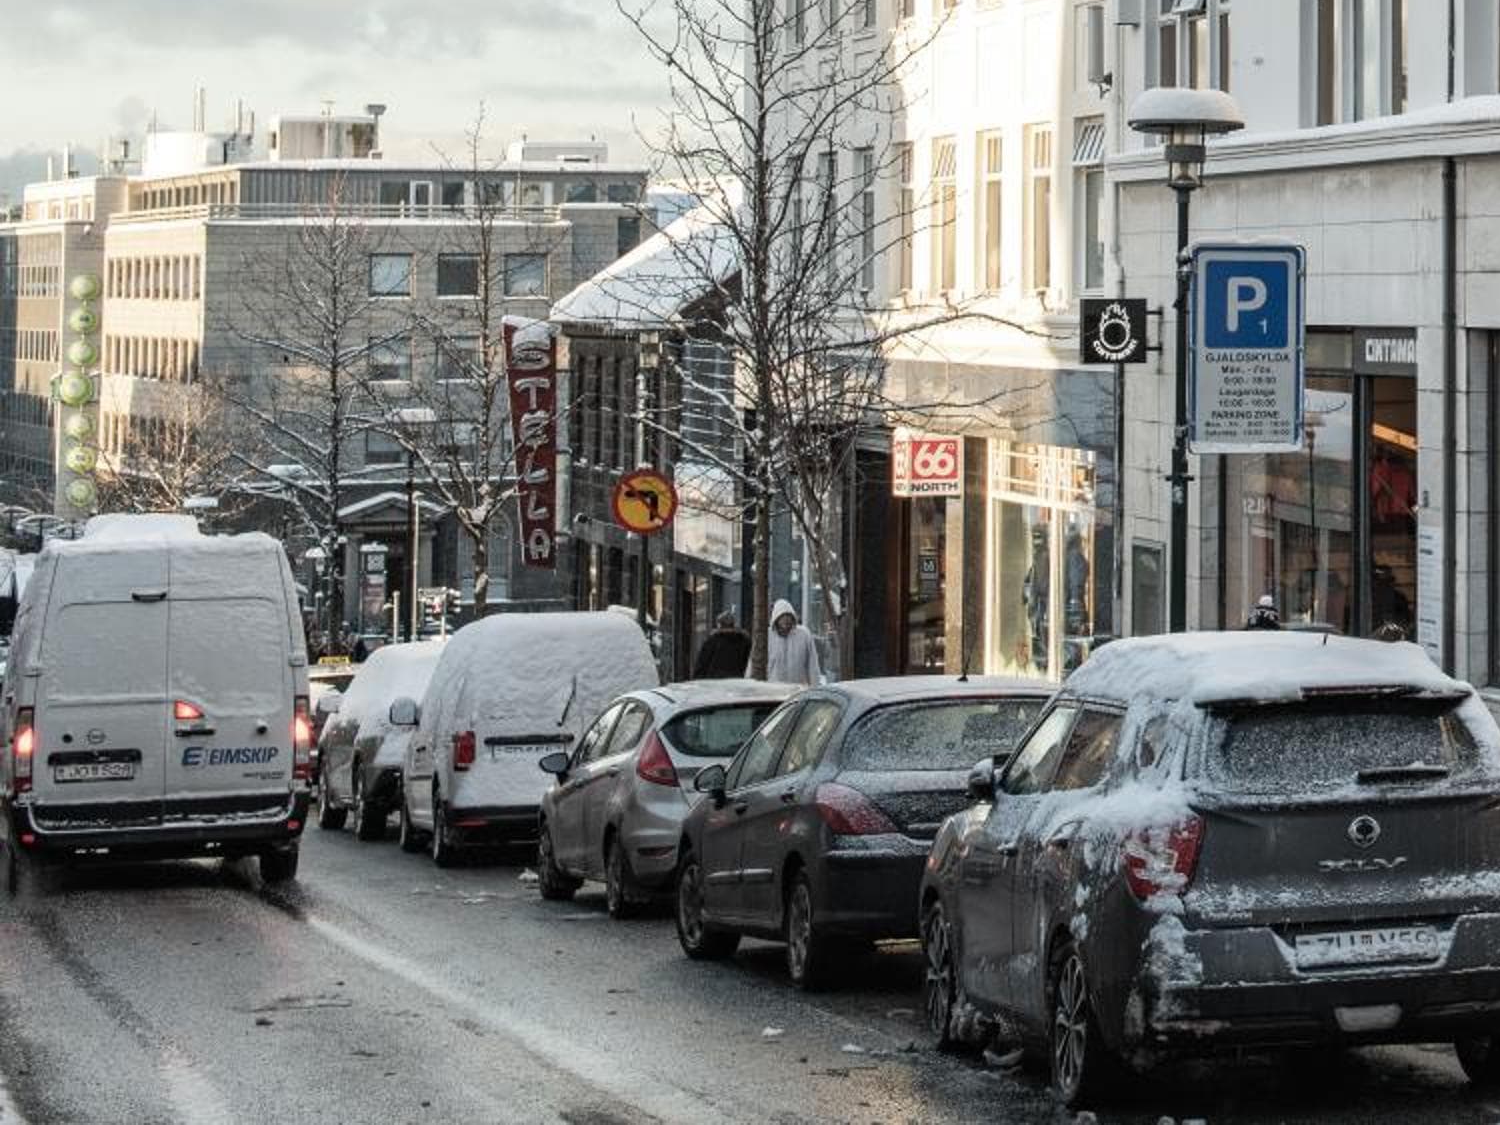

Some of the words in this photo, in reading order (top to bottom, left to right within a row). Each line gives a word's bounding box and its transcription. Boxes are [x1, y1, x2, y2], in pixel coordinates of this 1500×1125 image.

[1227, 276, 1268, 332] P
[1258, 318, 1268, 335] 1
[1365, 338, 1418, 363] CINTAMA
[911, 482, 958, 492] NORTH
[209, 746, 279, 765] EIMSKIP
